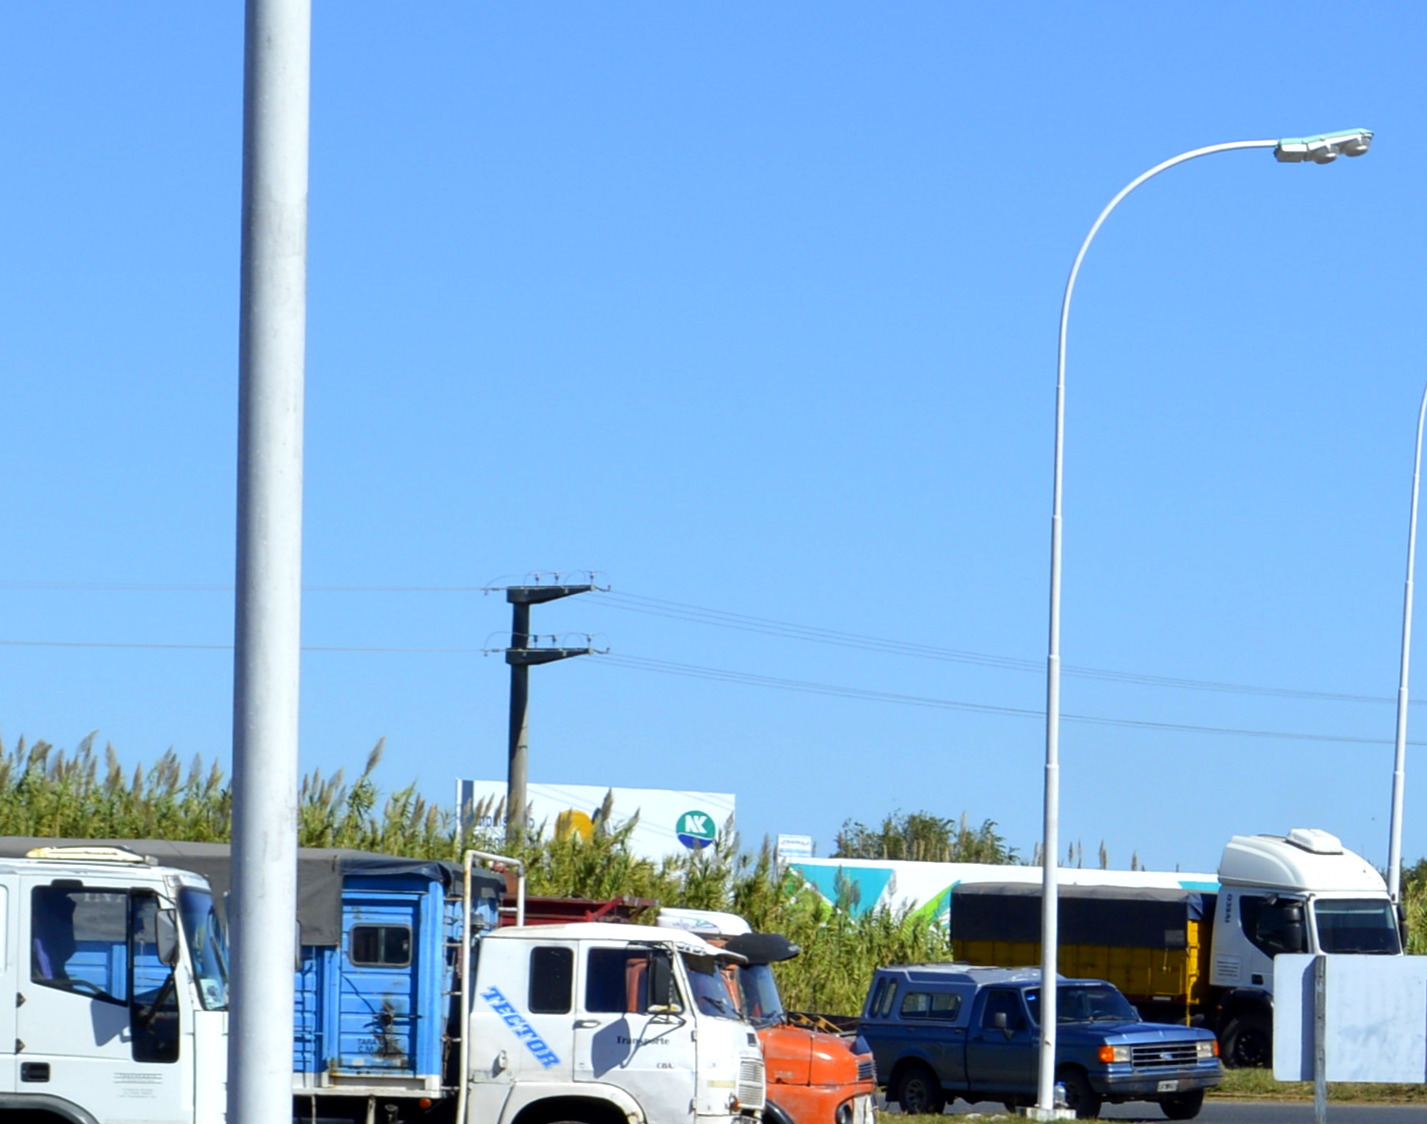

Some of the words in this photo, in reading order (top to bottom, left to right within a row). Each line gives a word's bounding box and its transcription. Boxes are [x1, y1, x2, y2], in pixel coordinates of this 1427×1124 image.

[1224, 893, 1233, 923] IVECO
[480, 985, 561, 1069] TECTOR
[616, 1035, 669, 1047] Tranporte
